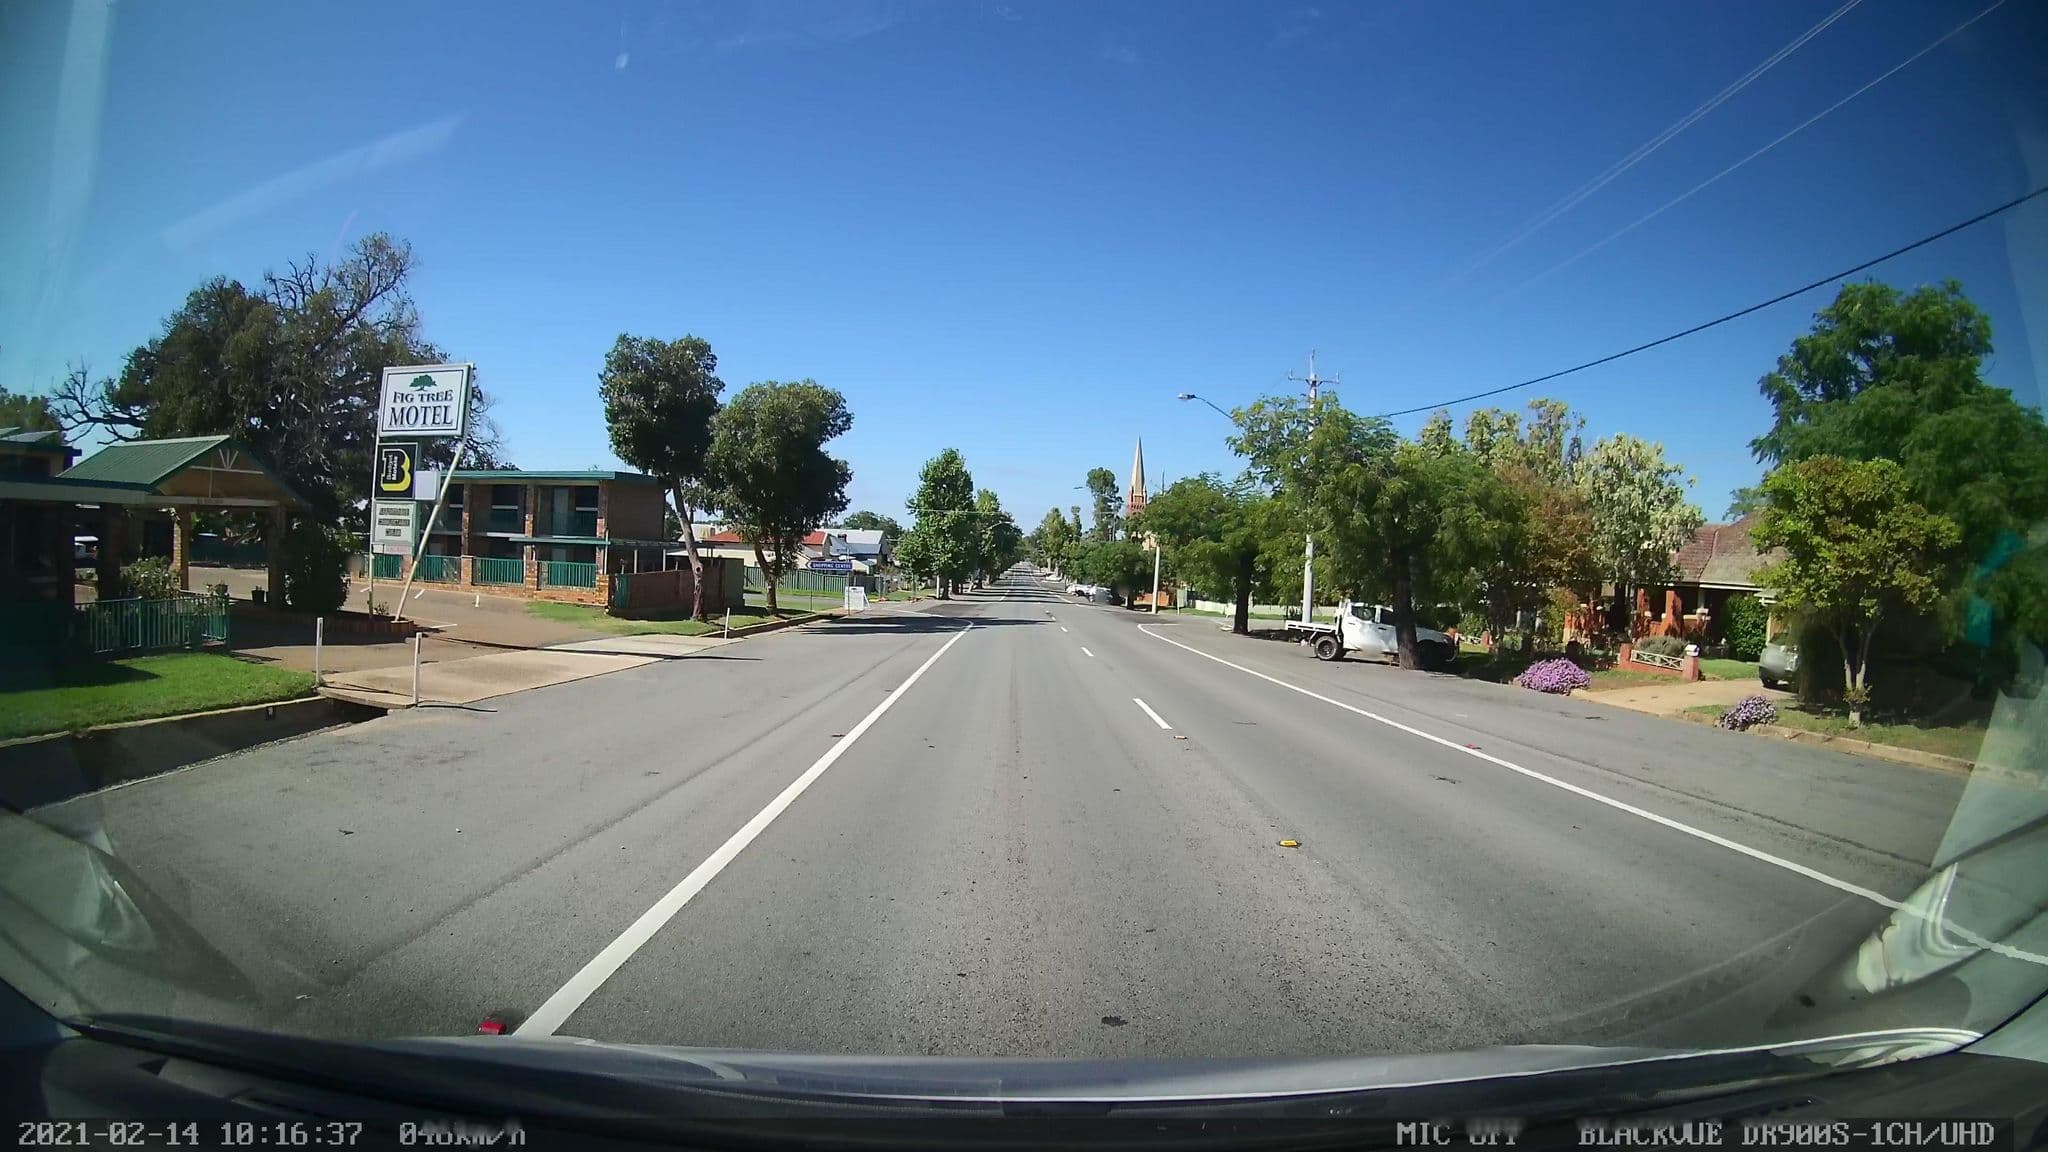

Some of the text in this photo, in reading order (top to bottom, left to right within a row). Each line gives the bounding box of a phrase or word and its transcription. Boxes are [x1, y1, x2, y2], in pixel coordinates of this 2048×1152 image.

[393, 390, 454, 404] FIG TREE
[388, 405, 454, 426] MOTEL
